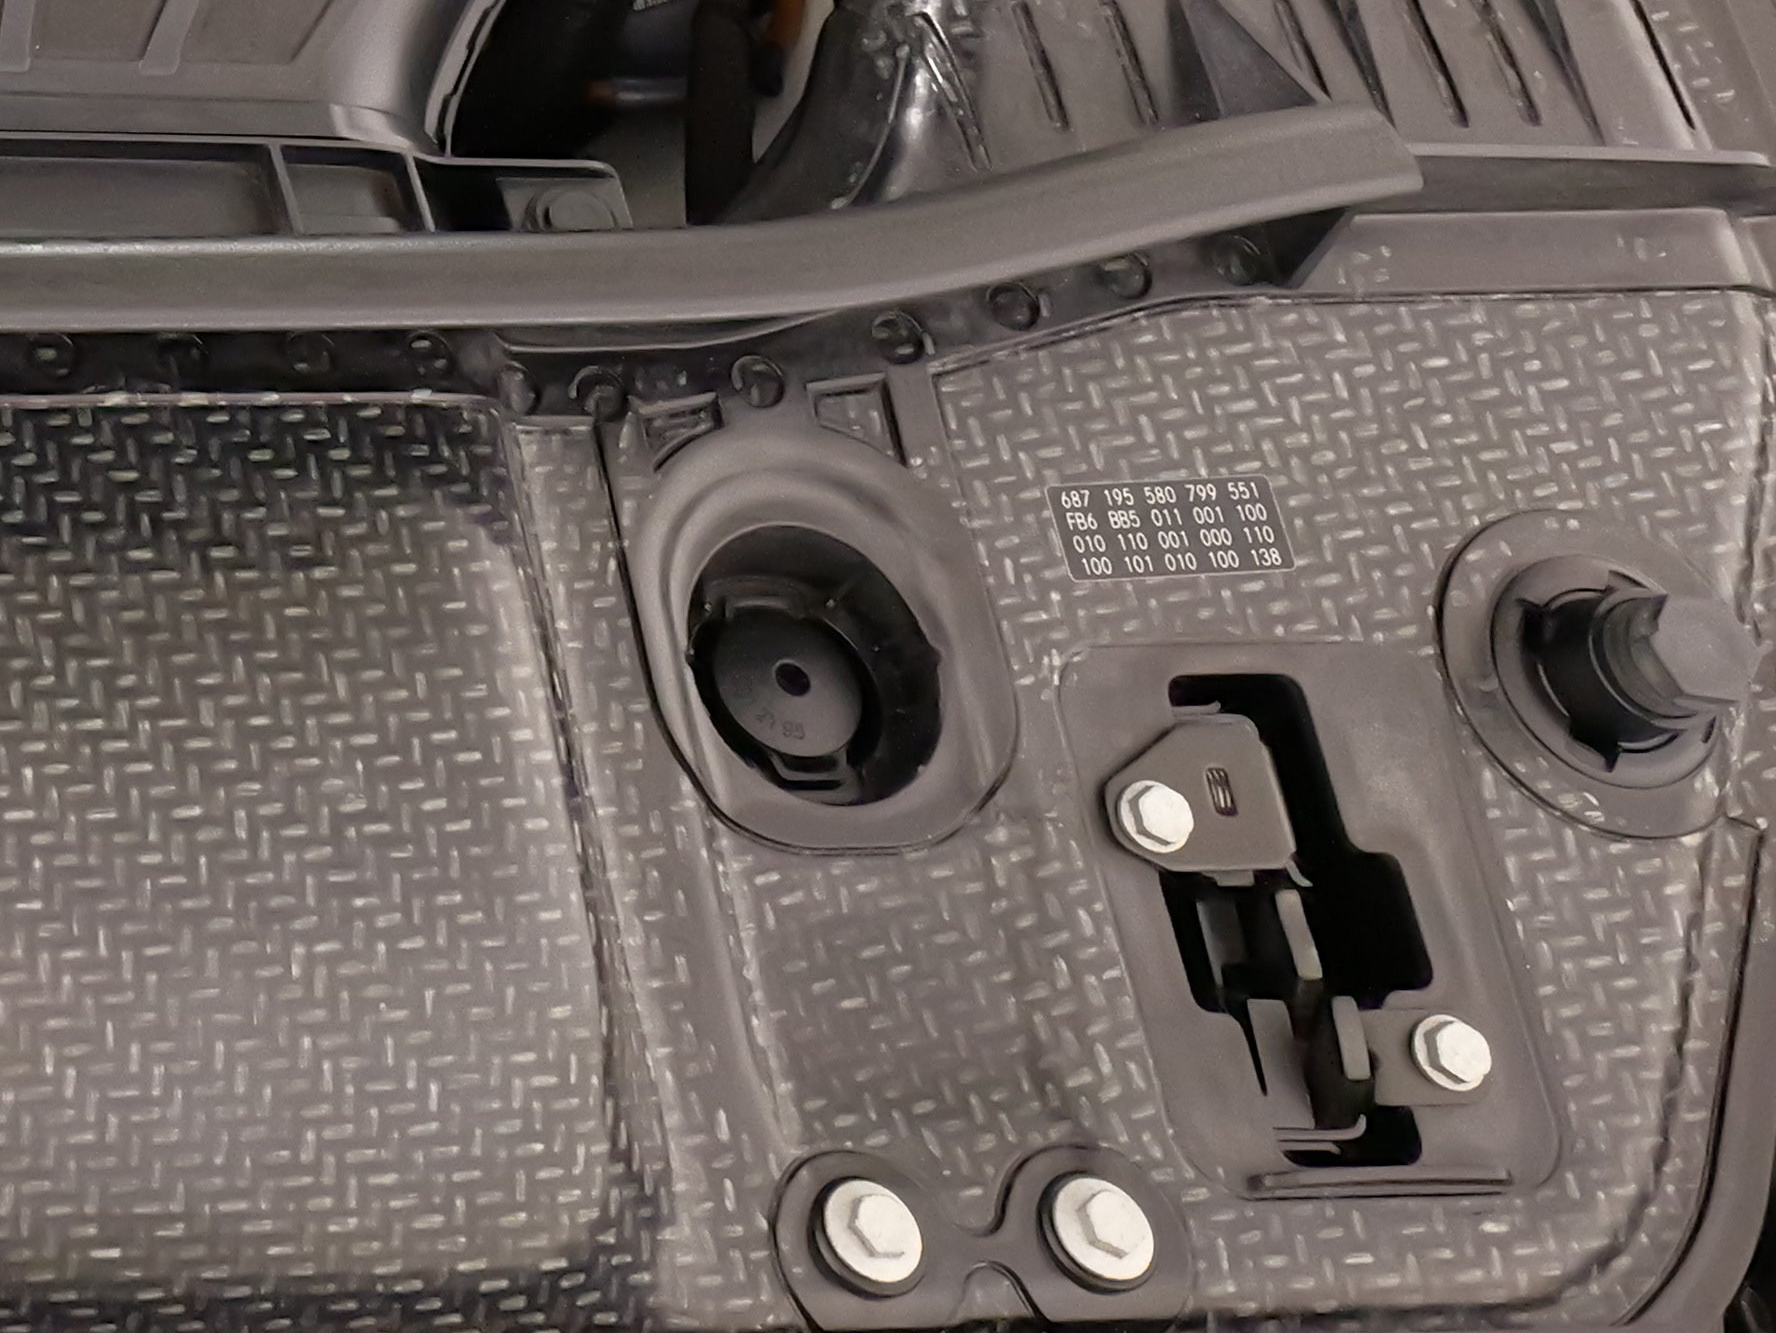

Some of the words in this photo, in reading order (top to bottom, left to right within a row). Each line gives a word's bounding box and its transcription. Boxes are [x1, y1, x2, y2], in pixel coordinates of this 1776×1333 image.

[1061, 490, 1090, 509] 687
[1104, 487, 1135, 507] 195
[1144, 486, 1177, 505] 580
[1185, 484, 1217, 502] 799
[1228, 481, 1260, 500] 551
[1066, 511, 1098, 532] FB6
[1108, 509, 1141, 529] BB5
[1150, 507, 1184, 527] 011
[1193, 505, 1224, 525] 001
[1236, 503, 1268, 522] 100
[1073, 534, 1106, 554] 010
[1118, 532, 1149, 551] 110
[1158, 530, 1190, 550] 001
[1200, 528, 1233, 547] 000
[1243, 525, 1275, 545] 110
[1081, 556, 1113, 576] 100
[1124, 555, 1154, 574] 101
[1164, 552, 1197, 572] 010
[1209, 550, 1240, 570] 100
[1251, 547, 1282, 567] 138
